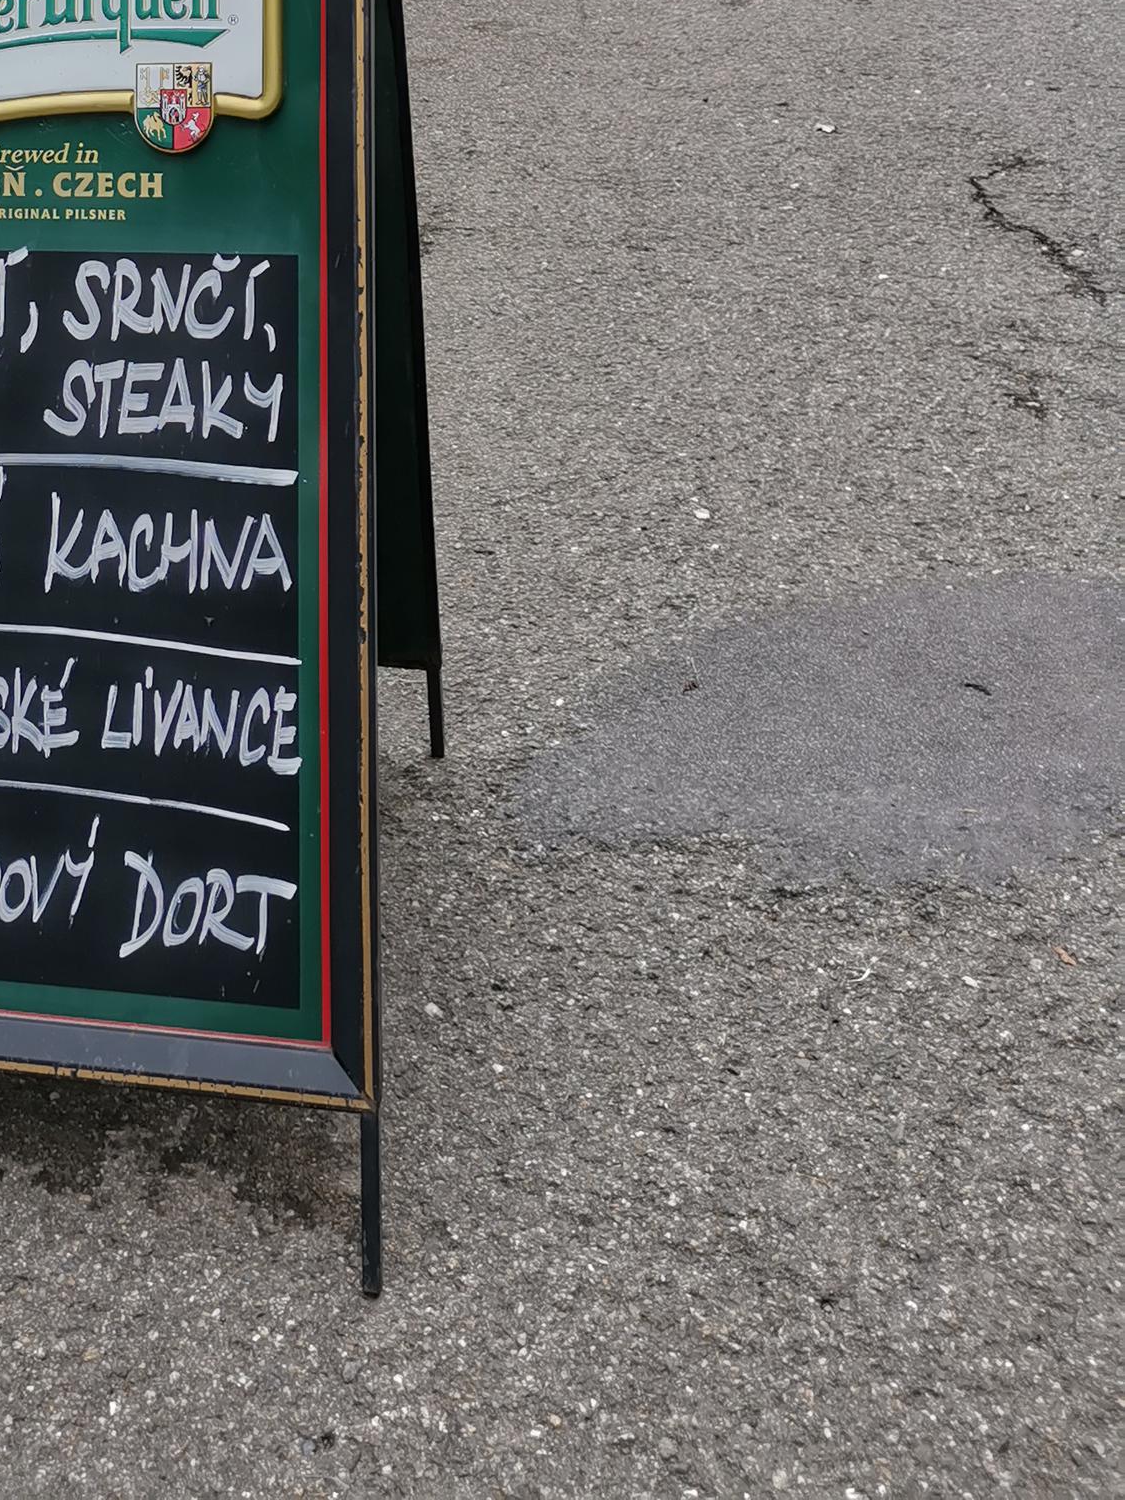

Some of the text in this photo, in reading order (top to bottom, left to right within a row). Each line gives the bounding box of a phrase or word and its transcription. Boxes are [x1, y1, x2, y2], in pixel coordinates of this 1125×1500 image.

[52, 171, 165, 199] CZECH
[75, 141, 100, 165] in
[65, 208, 127, 221] PILSNER
[62, 253, 277, 352] SRNČÍ,
[42, 355, 283, 443] STEAKY
[43, 491, 293, 594] KACHNA
[100, 666, 303, 775] LÍVANCE
[118, 848, 298, 958] DORT
